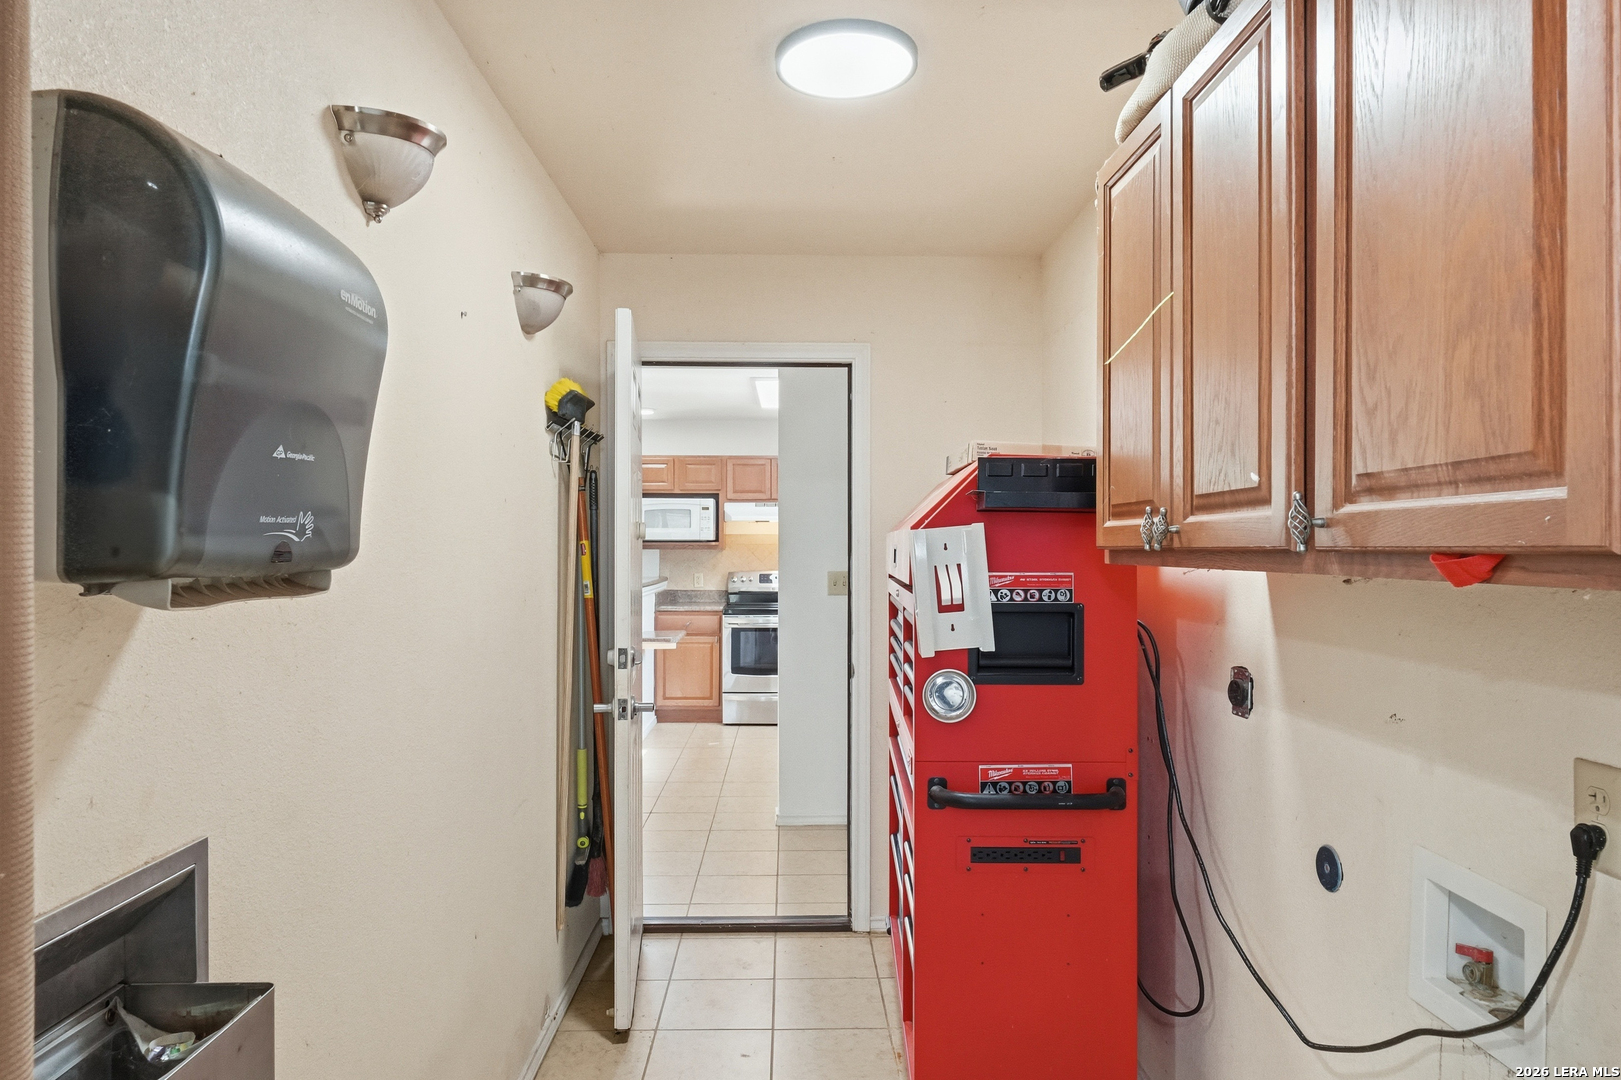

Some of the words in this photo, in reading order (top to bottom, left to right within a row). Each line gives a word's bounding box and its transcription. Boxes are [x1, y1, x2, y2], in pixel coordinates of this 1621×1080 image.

[340, 289, 377, 318] enMotion
[259, 515, 276, 523] Motion
[276, 515, 297, 524] Activated
[987, 768, 1013, 779] Milwaukee
